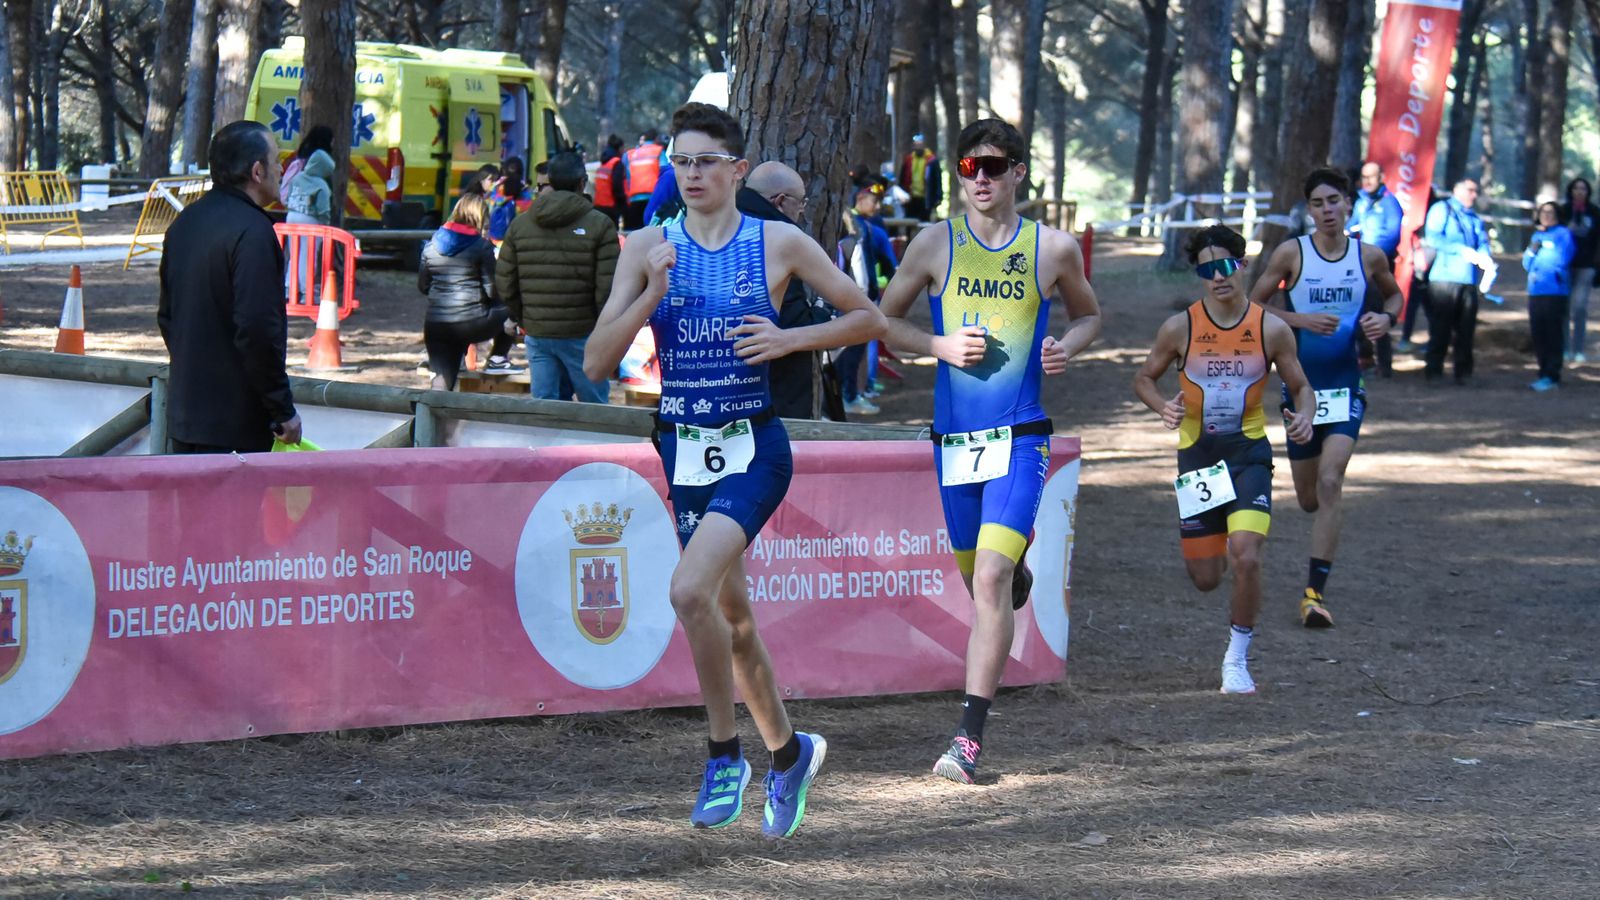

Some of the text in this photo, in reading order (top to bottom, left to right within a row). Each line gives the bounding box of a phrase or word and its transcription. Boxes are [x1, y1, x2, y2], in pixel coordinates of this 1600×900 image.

[1398, 17, 1435, 138] Deporte
[957, 276, 1025, 300] RAMOS
[1309, 287, 1353, 304] VALENTIN
[676, 348, 737, 359] MARPEDE
[697, 361, 718, 369] Dental
[662, 373, 761, 388] erreteriaelbambin.com
[1207, 361, 1244, 377] ESPEJO
[1317, 401, 1329, 417] 5
[704, 446, 726, 473] 6
[969, 446, 986, 472] 7
[1196, 481, 1212, 502] 3
[751, 530, 869, 567] Ayuntamiento
[874, 530, 894, 556] de
[899, 528, 931, 555] San
[108, 545, 472, 593] Ilustre Ayuntamiento de San Roque
[745, 566, 944, 602] GACIÓN DE DEPORTES
[108, 590, 415, 638] DELEGACIÓN DE DEPORTES
